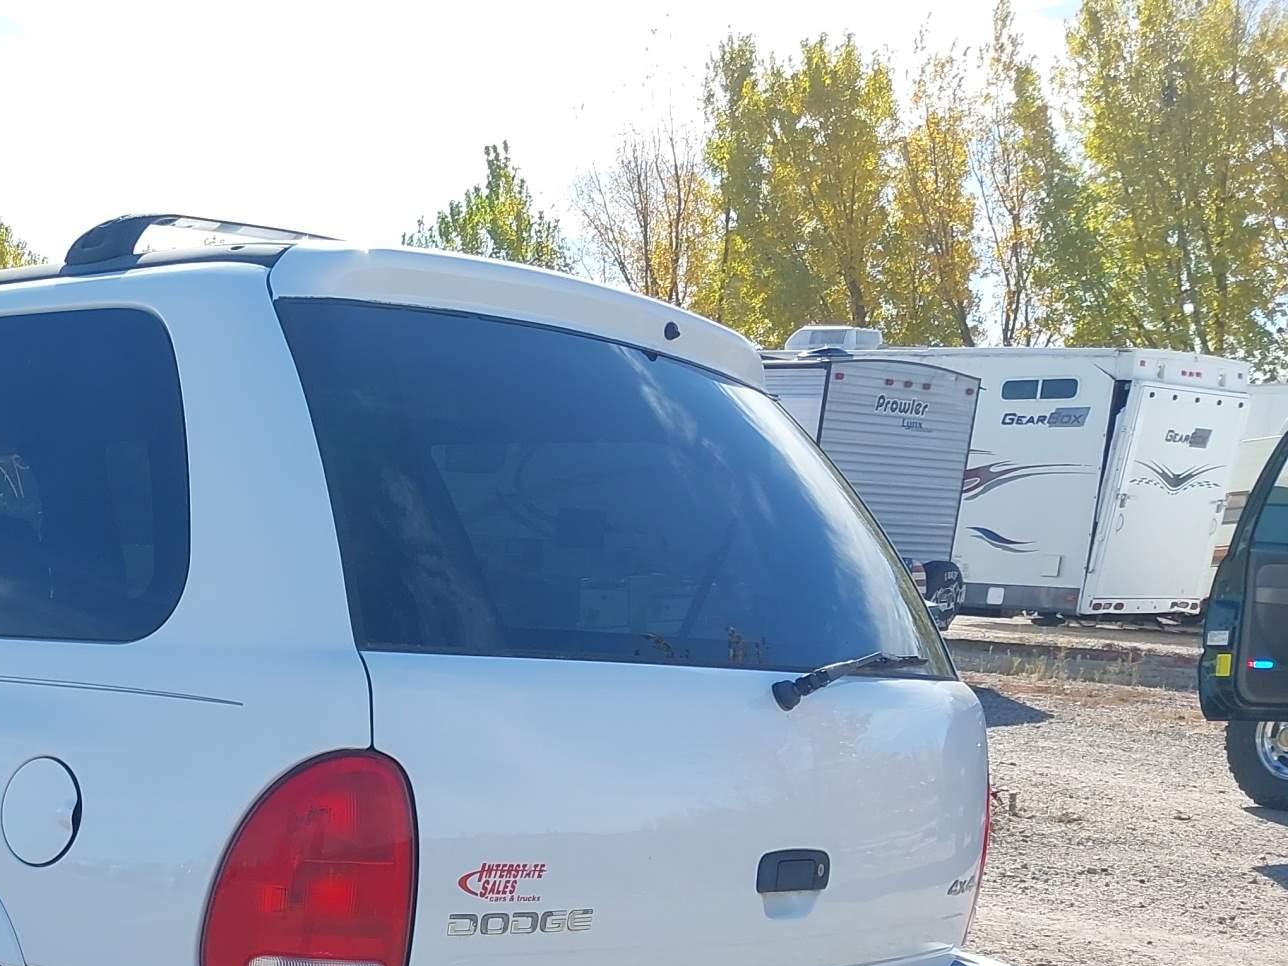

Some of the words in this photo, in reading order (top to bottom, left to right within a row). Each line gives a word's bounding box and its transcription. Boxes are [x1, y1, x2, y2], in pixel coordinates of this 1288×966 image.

[875, 395, 929, 416] Prowler
[901, 418, 923, 431] Lynx
[477, 862, 547, 882] INTERSTATE
[479, 880, 518, 898] SALES
[517, 894, 541, 902] trucks
[447, 908, 594, 937] DODGE
